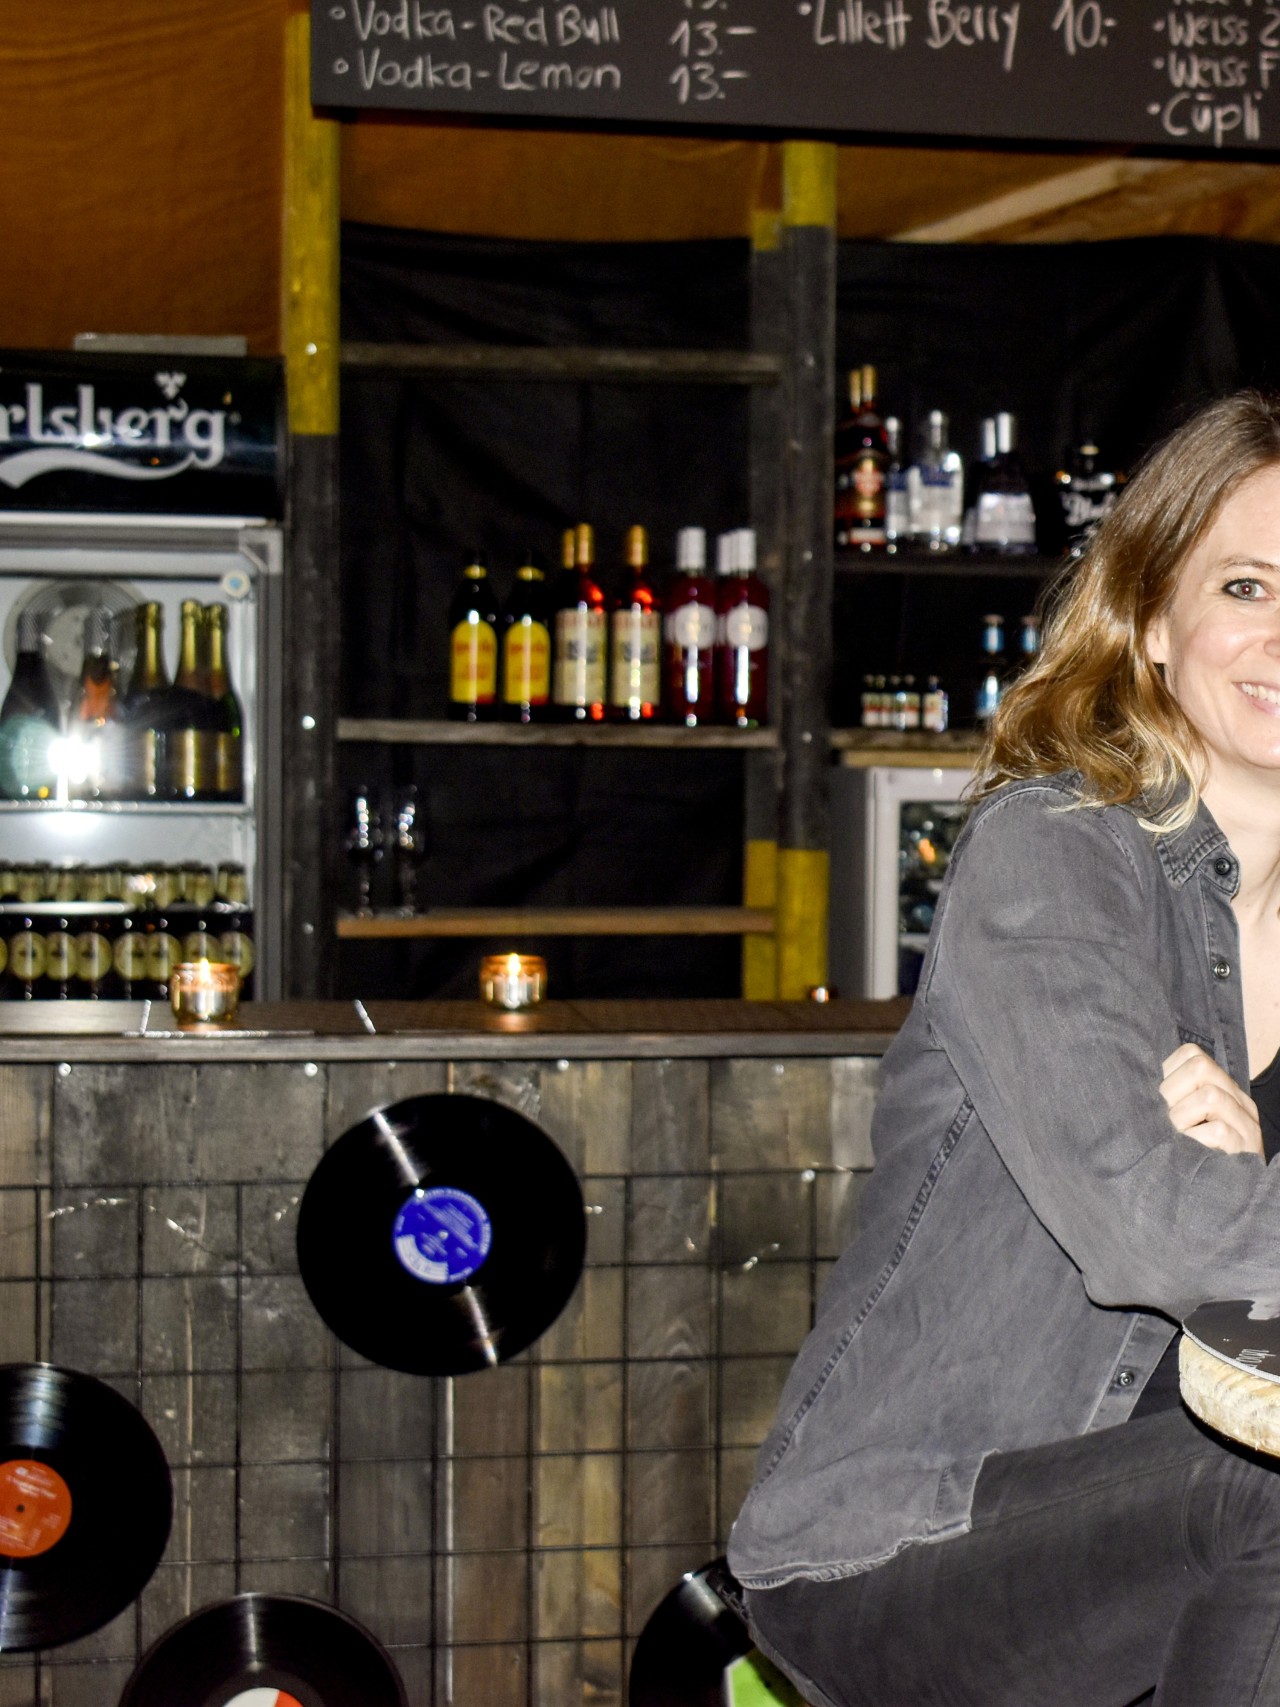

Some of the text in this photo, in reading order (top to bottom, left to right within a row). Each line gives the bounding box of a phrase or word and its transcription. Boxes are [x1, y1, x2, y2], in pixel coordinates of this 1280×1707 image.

[556, 6, 621, 46] Bull
[925, 0, 1020, 72] Berry
[1168, 10, 1249, 48] Weiss
[1168, 51, 1249, 88] Weiss
